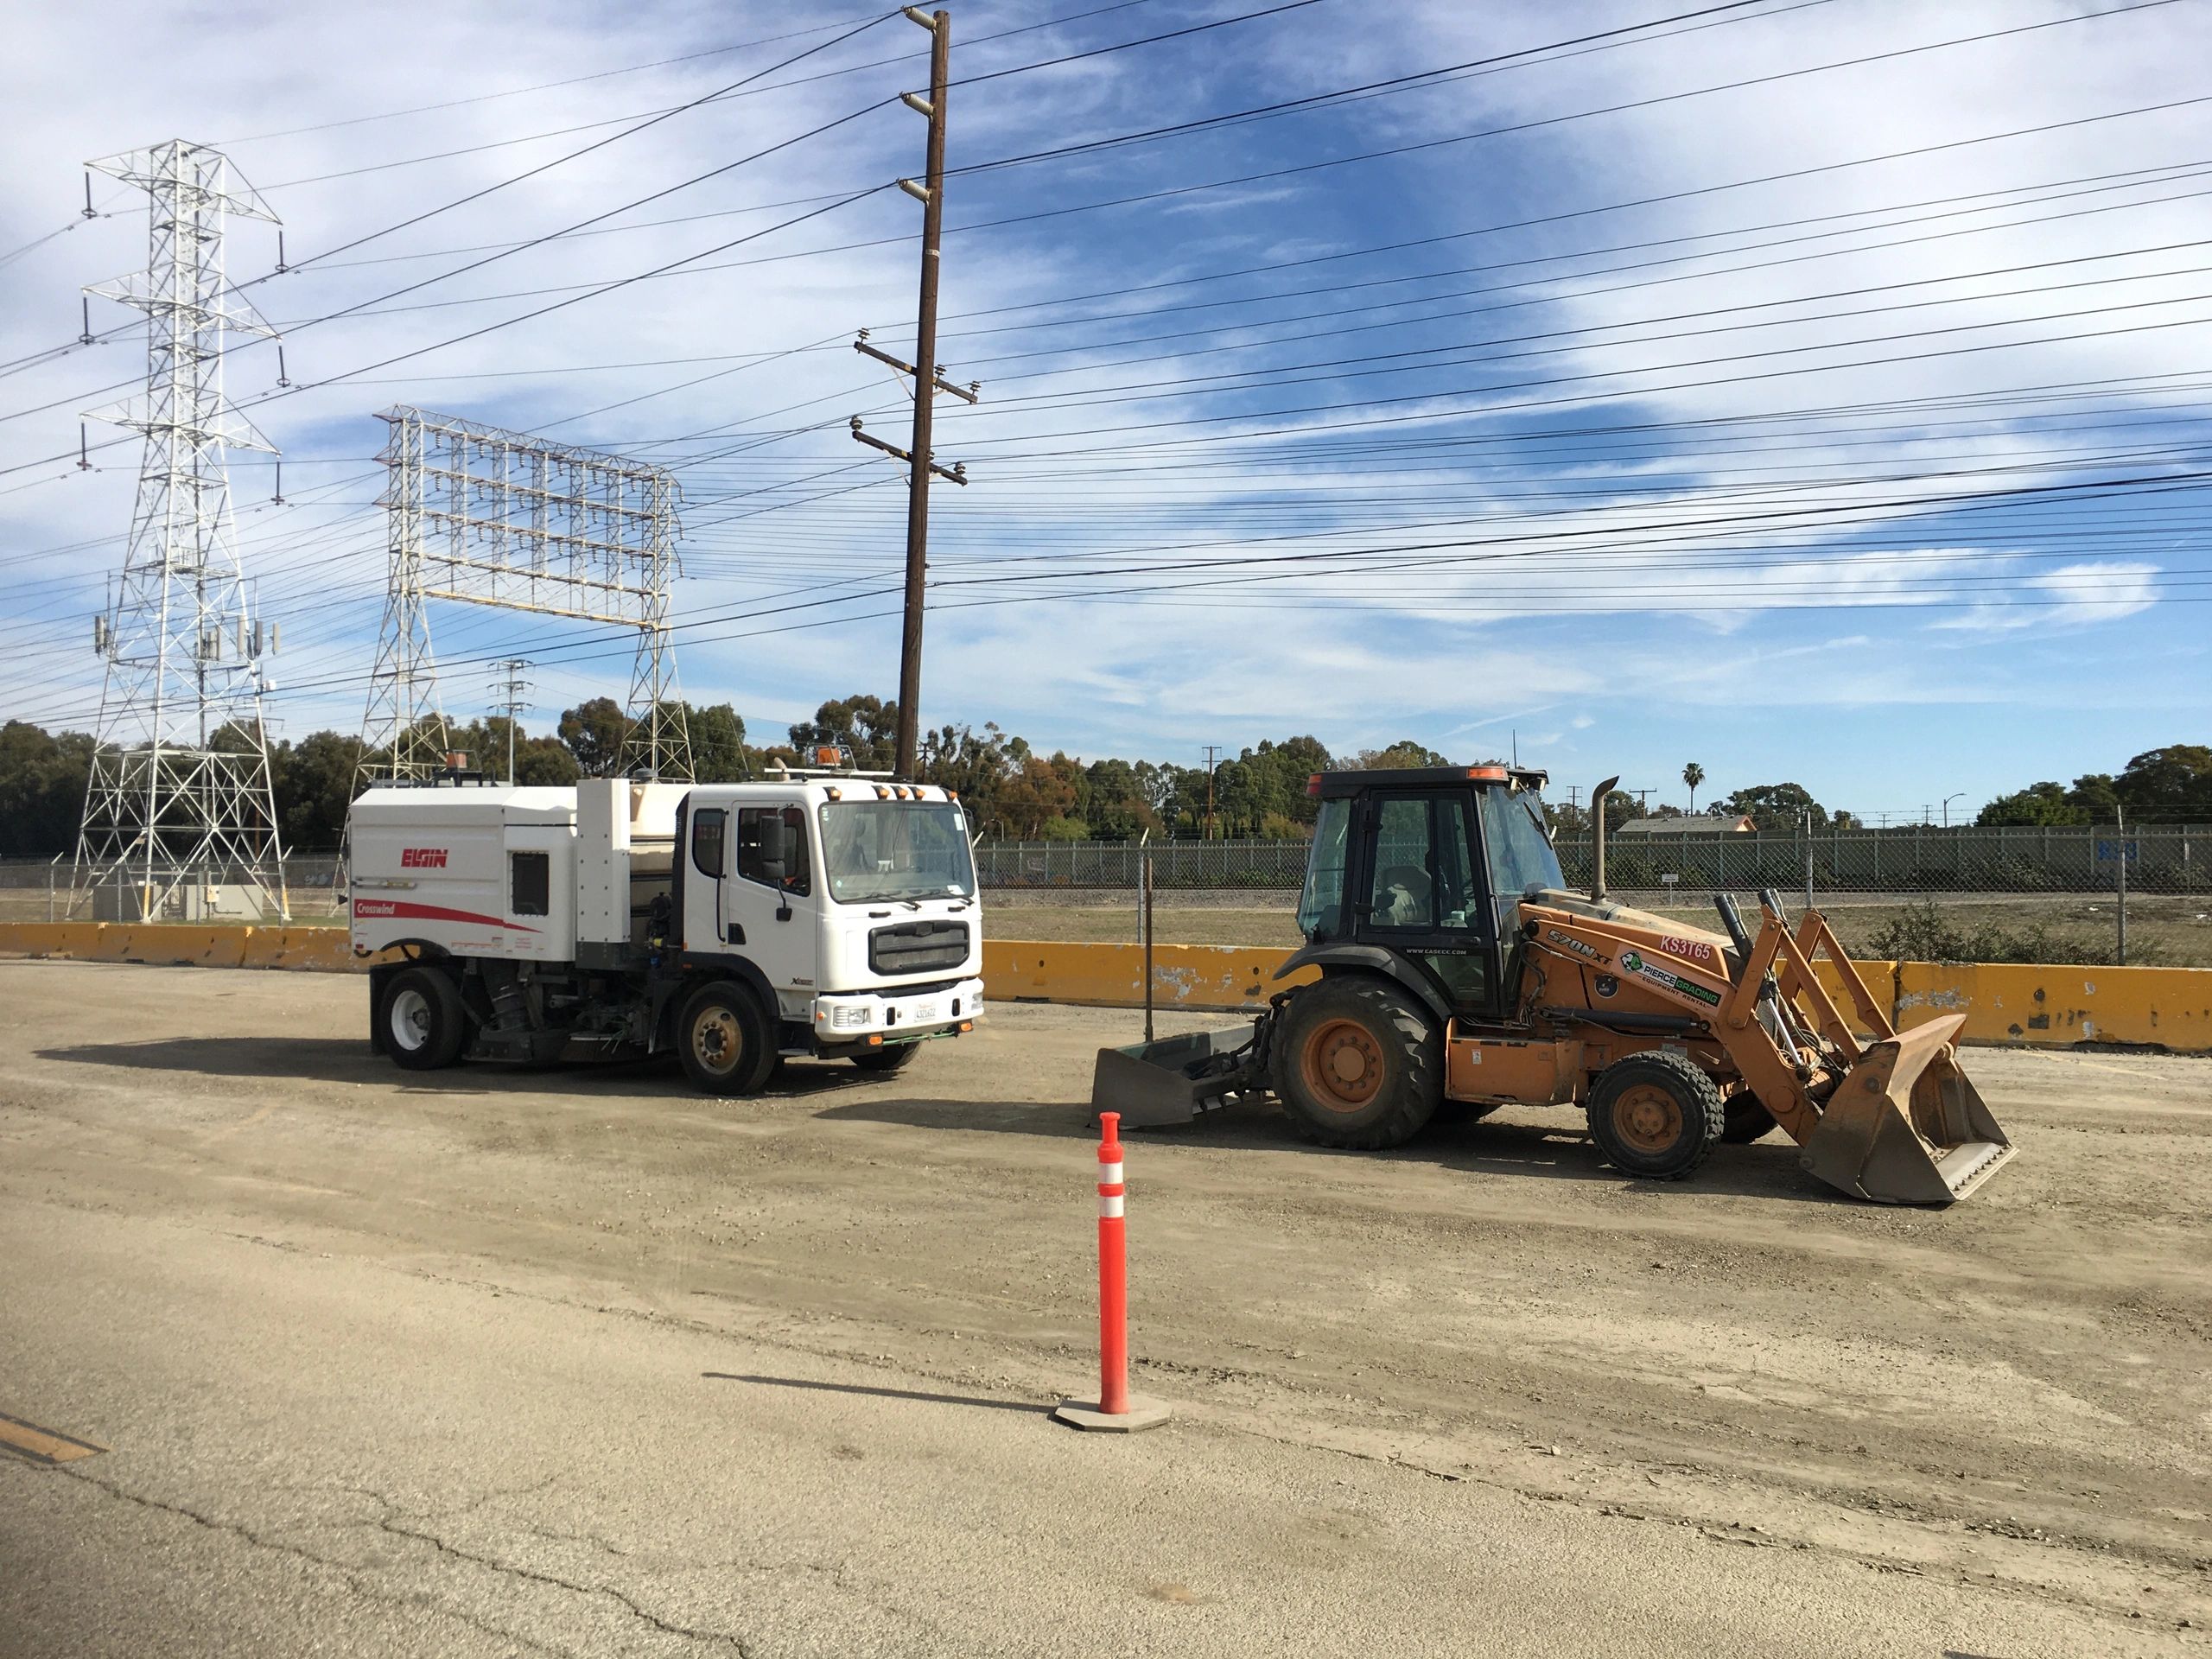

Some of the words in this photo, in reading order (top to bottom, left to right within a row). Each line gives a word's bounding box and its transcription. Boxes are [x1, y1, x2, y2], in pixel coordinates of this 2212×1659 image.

[401, 849, 448, 868] ELGIN
[357, 902, 396, 915] Crosswind
[1546, 929, 1596, 957] 570N
[1592, 952, 1613, 965] XT
[1660, 935, 1711, 960] KS3T65
[1642, 977, 1680, 996] EQUIPMENT
[1681, 994, 1707, 1009] RENTAL
[1643, 965, 1676, 985] PIERCE
[1675, 980, 1718, 1004] GRADING
